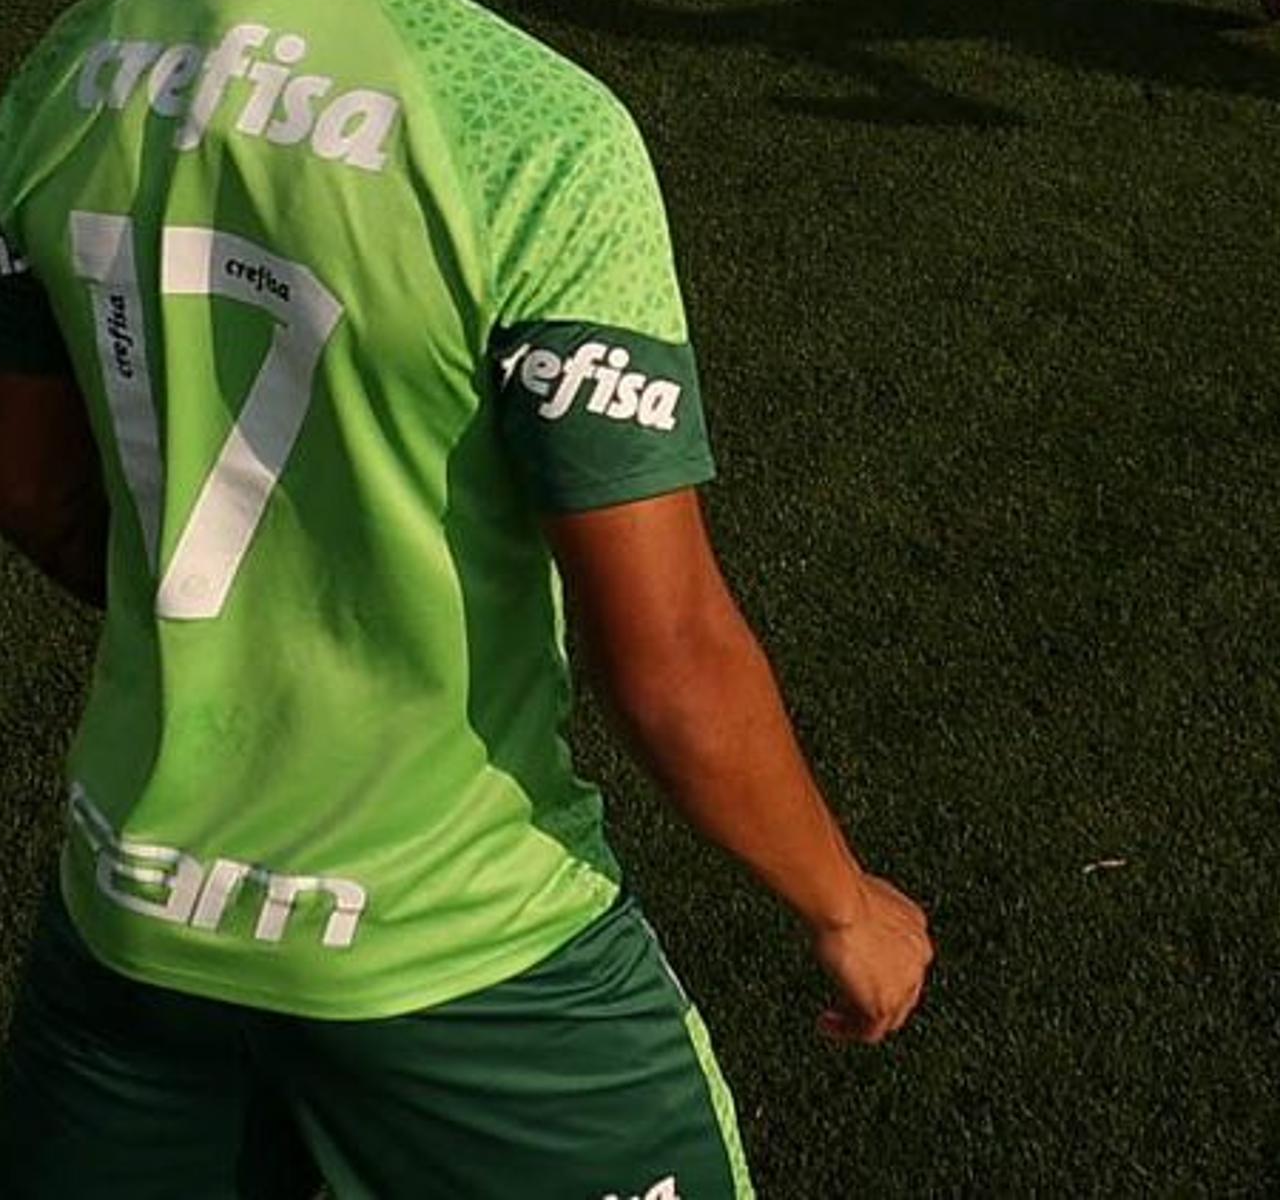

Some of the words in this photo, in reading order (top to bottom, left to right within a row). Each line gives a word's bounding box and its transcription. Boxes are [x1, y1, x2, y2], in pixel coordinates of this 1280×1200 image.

[75, 23, 403, 172] crefisa
[113, 293, 133, 381] crefisa
[224, 256, 291, 303] crefisa
[69, 210, 345, 620] 17
